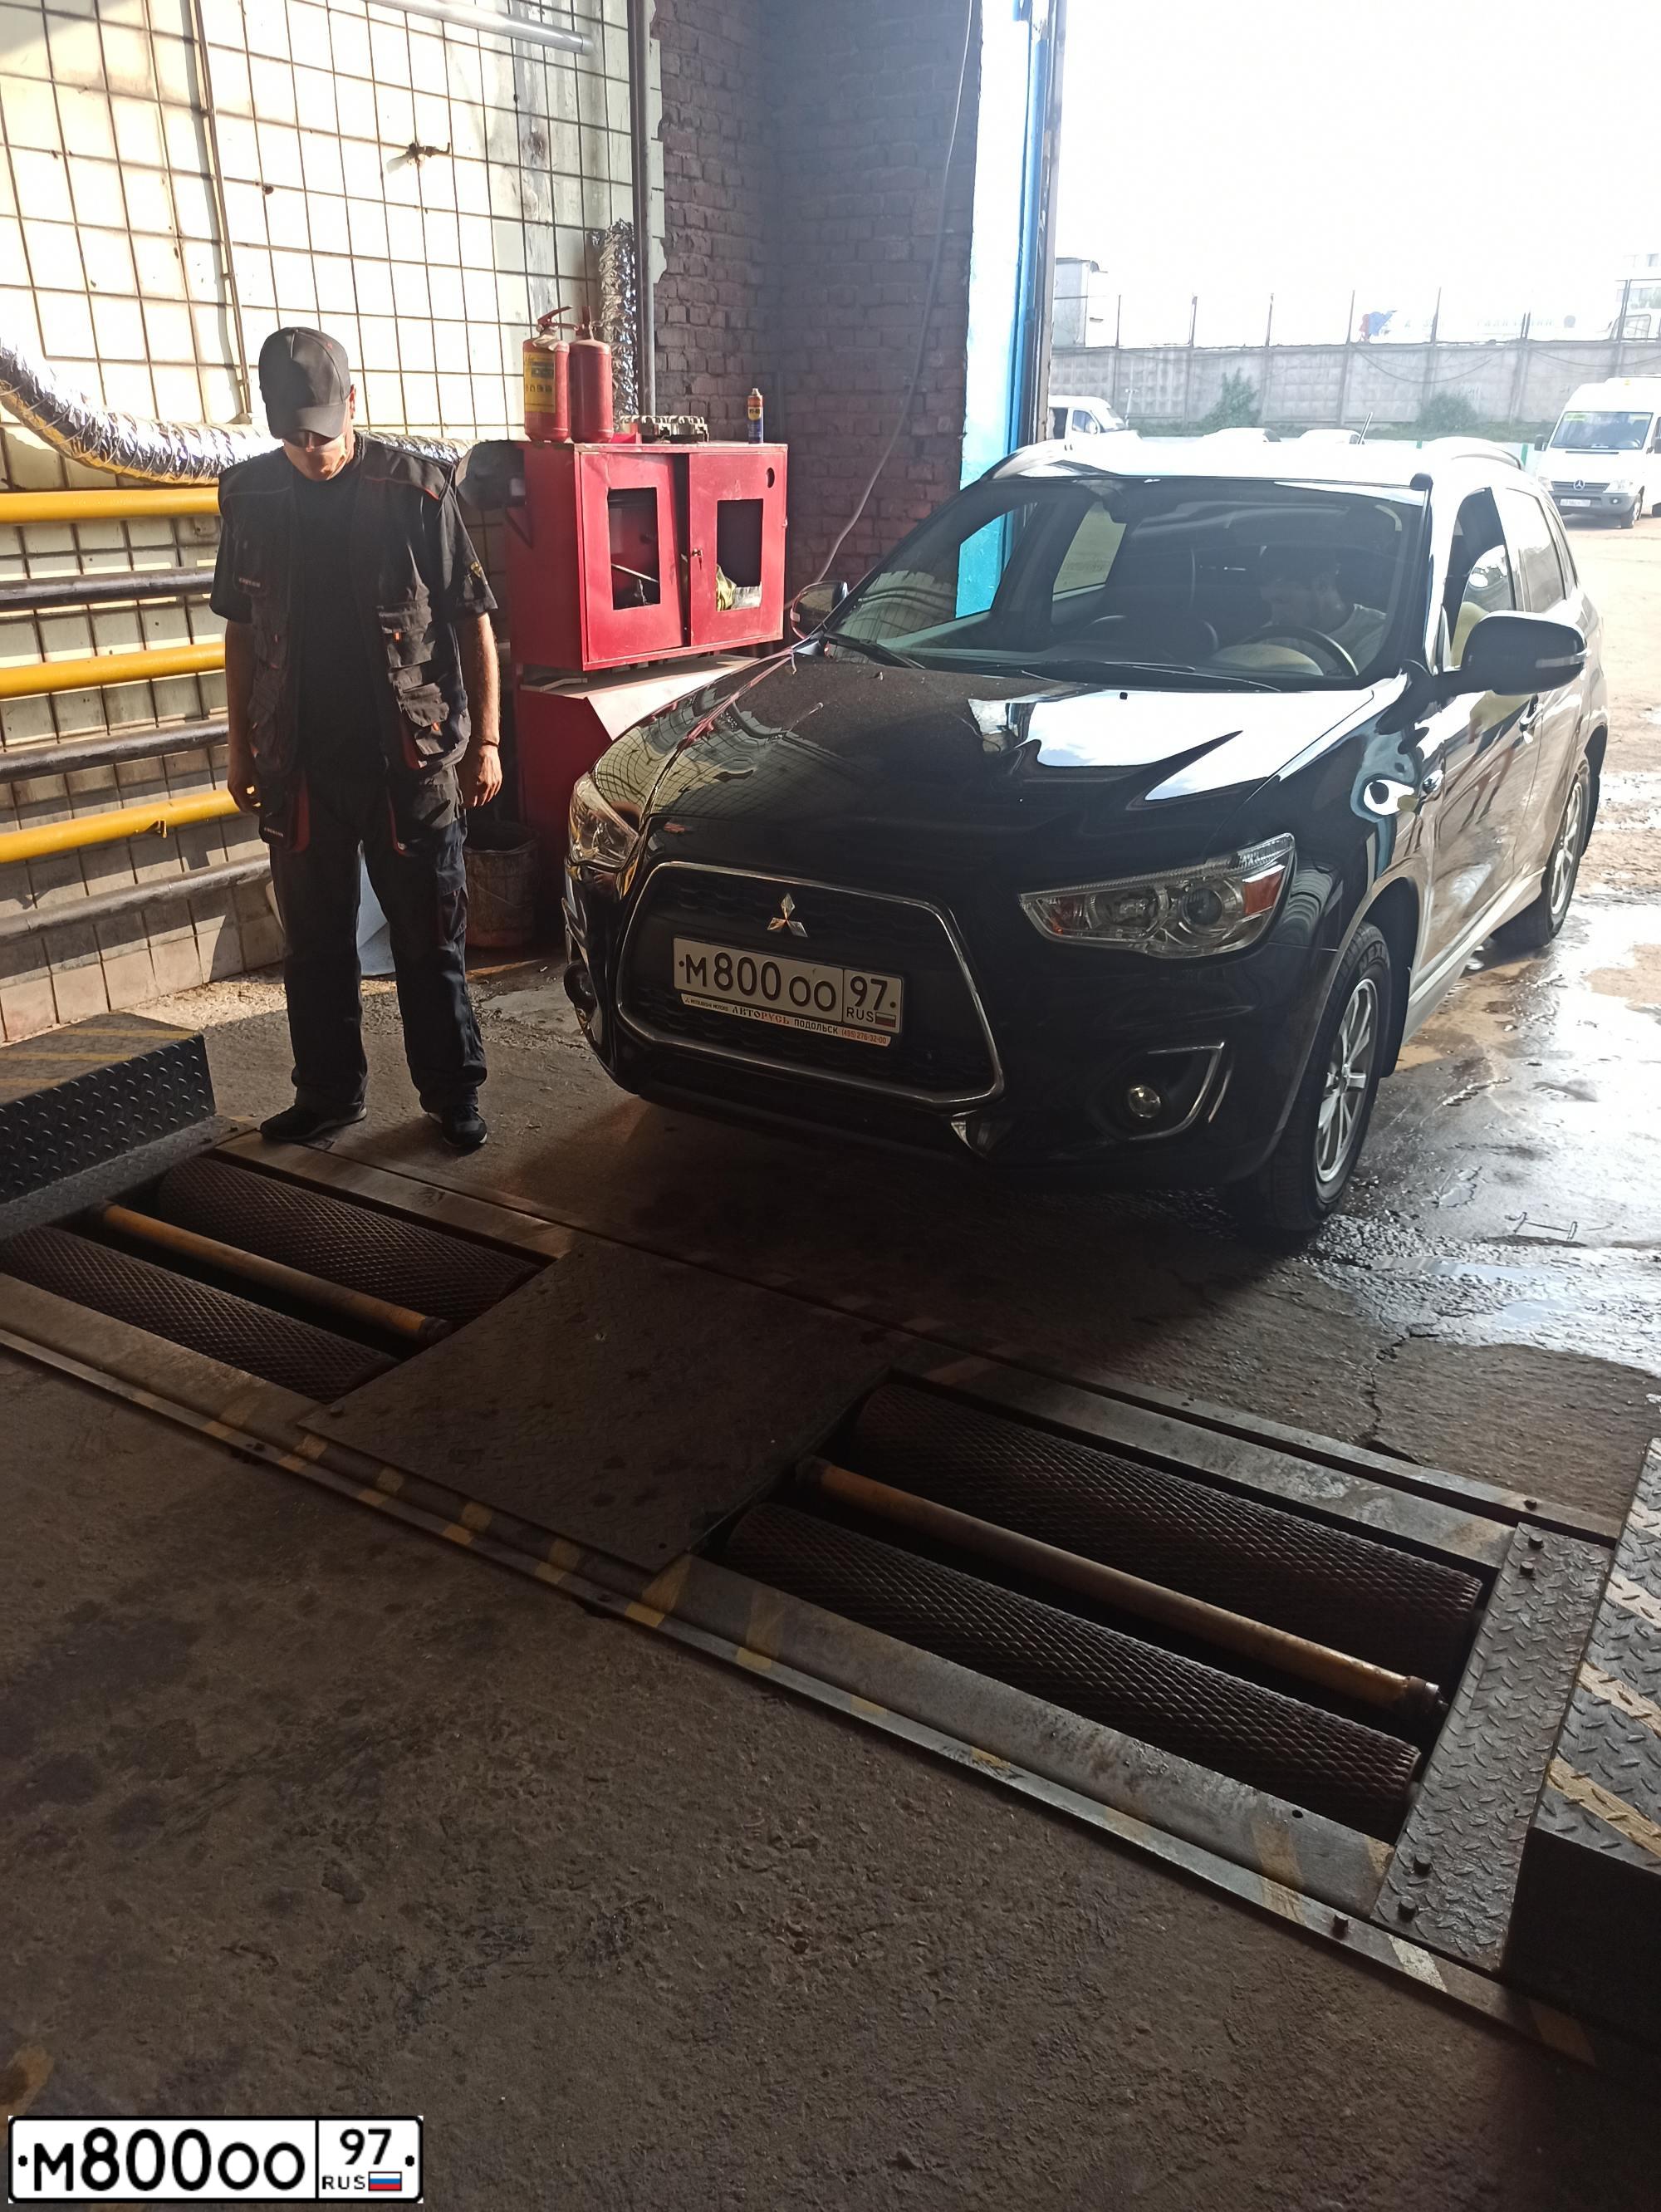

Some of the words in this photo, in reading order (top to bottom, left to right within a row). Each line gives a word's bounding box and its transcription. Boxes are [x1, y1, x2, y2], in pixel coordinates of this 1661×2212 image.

[685, 952, 836, 1012] М800ОО
[850, 975, 888, 1011] 97
[732, 1006, 790, 1024] АВТОРУСЬ
[794, 1018, 839, 1035] ПОДОЛЬСК
[846, 1007, 875, 1023] RUS
